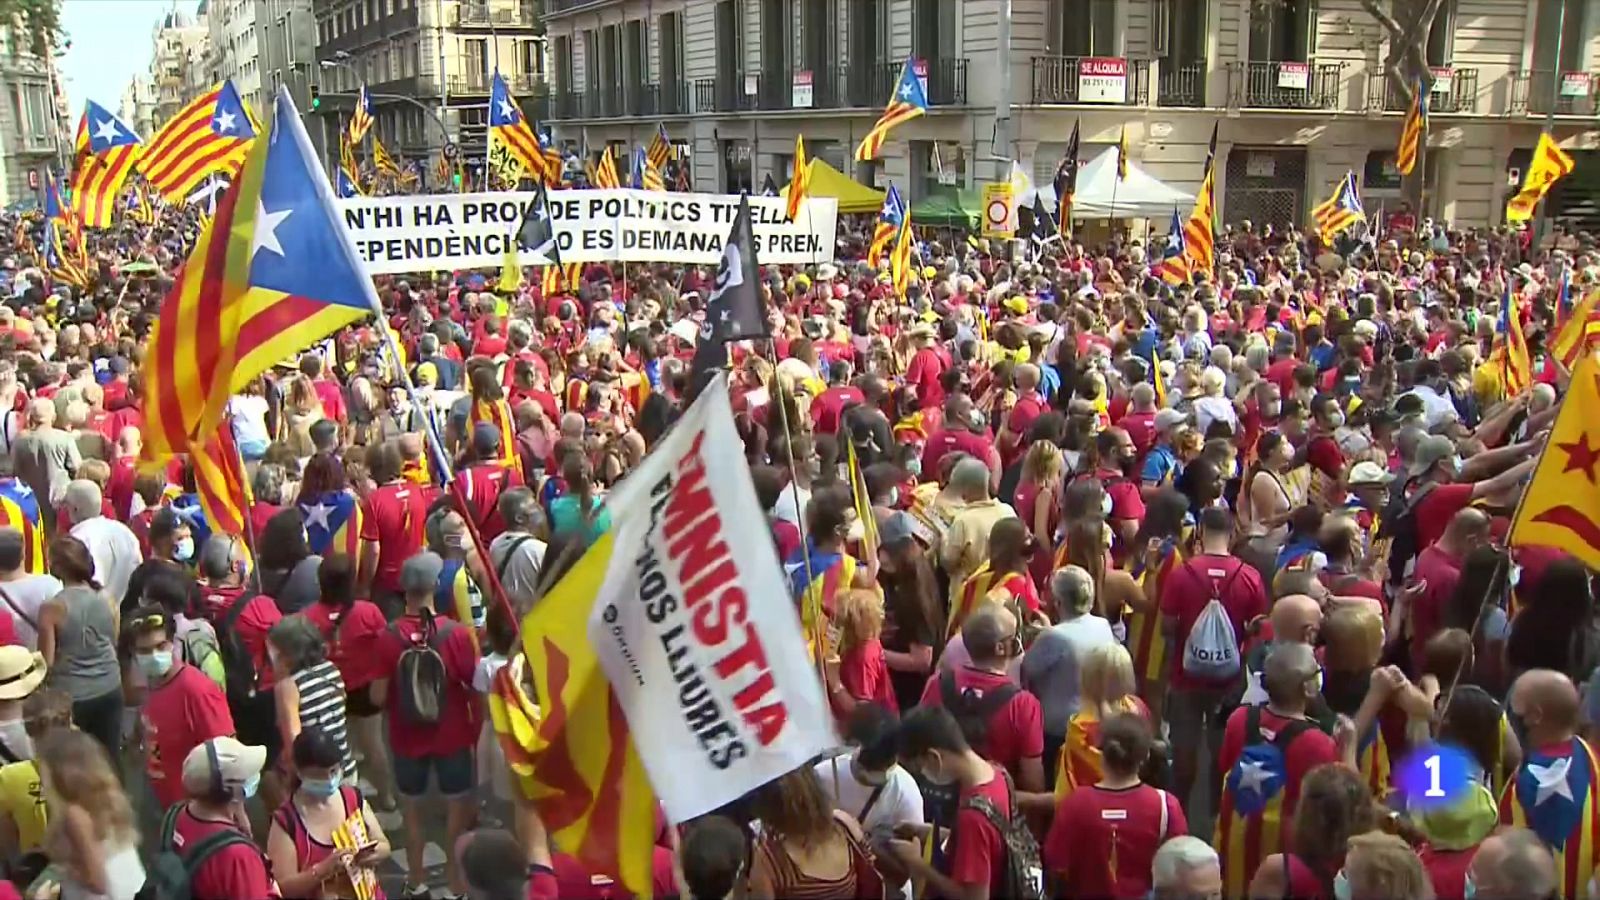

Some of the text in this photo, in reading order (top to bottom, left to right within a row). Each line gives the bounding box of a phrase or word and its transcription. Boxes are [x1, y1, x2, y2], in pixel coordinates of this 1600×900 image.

[1082, 62, 1123, 74] SE ALQUILA
[345, 207, 403, 230] N'HI
[413, 204, 453, 222] HA
[550, 200, 580, 220] DE
[589, 198, 701, 222] POLITICS
[583, 229, 614, 250] ES
[622, 229, 722, 252] DEMANA
[768, 234, 823, 253] PREN.
[1190, 644, 1232, 661] VOIZE
[660, 623, 746, 771] LLIURES
